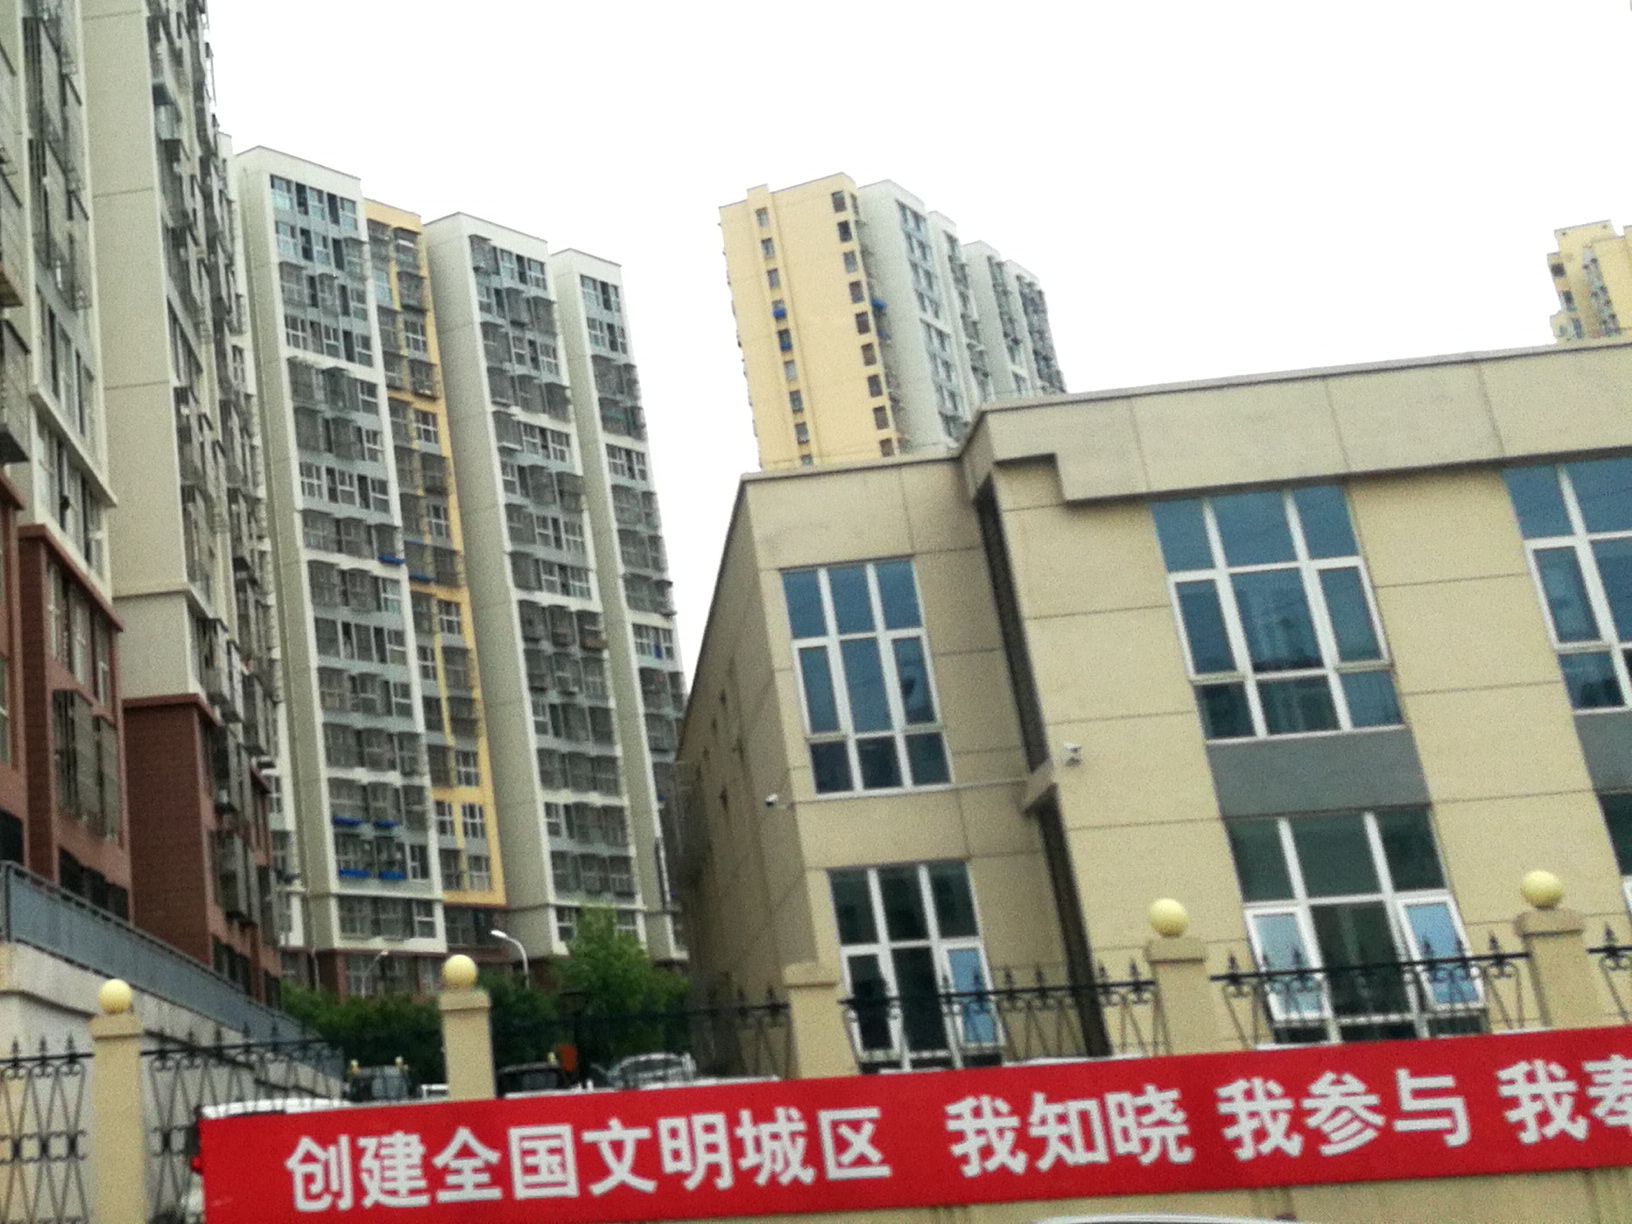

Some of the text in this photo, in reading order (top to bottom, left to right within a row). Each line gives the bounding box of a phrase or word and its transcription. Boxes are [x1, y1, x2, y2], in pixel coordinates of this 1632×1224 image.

[285, 1106, 892, 1212] 创建全国文明城区
[944, 1085, 1194, 1178] 我知晓
[1216, 1070, 1470, 1162] 我参与
